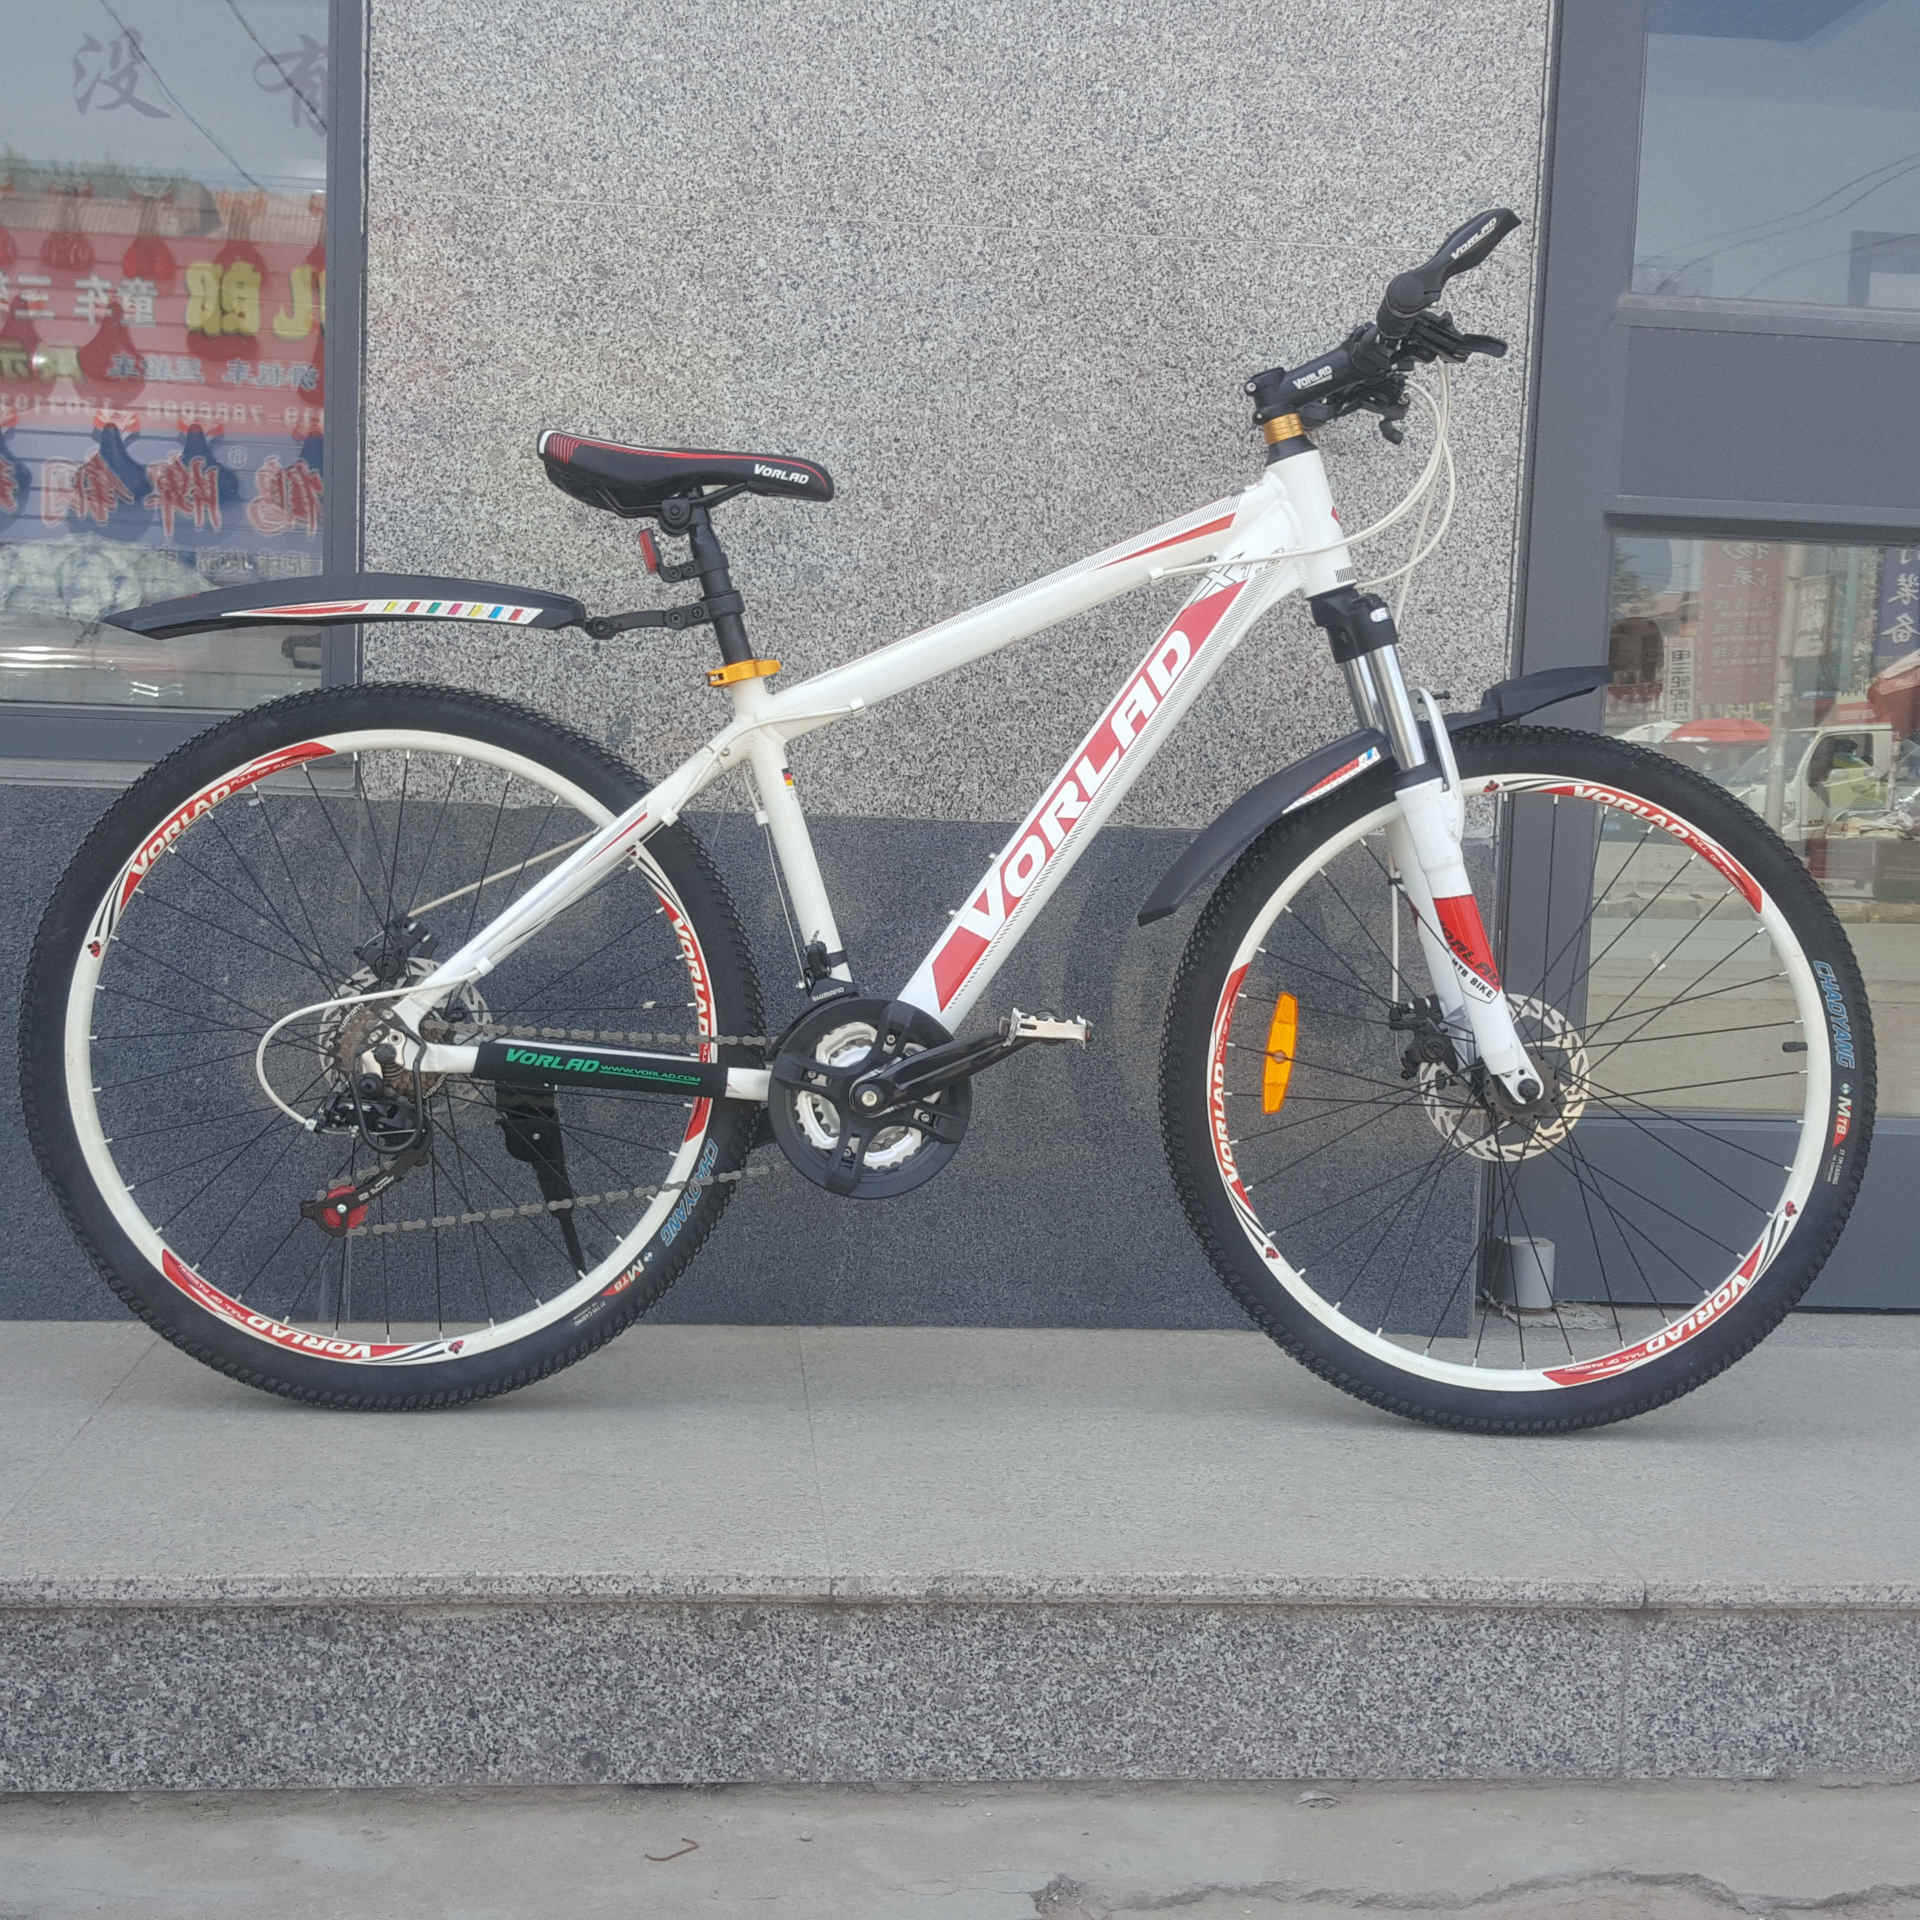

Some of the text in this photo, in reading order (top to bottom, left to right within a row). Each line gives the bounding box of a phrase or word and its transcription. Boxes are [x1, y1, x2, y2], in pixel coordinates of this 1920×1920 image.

[1292, 365, 1333, 388] VORLAD
[753, 463, 810, 486] VORLAD
[958, 630, 1192, 938] VORLAD
[1573, 784, 1689, 839] VORLAD
[130, 783, 232, 876] VORLAD
[672, 917, 710, 1036] VORLAD
[1469, 977, 1494, 998] BIKE
[1813, 959, 1855, 1070] CHAOYANG
[506, 1048, 601, 1073] VORLAD
[1212, 1063, 1240, 1183] VORLAD
[247, 1315, 371, 1358] VORLAD
[1646, 1274, 1749, 1353] VORLAD
